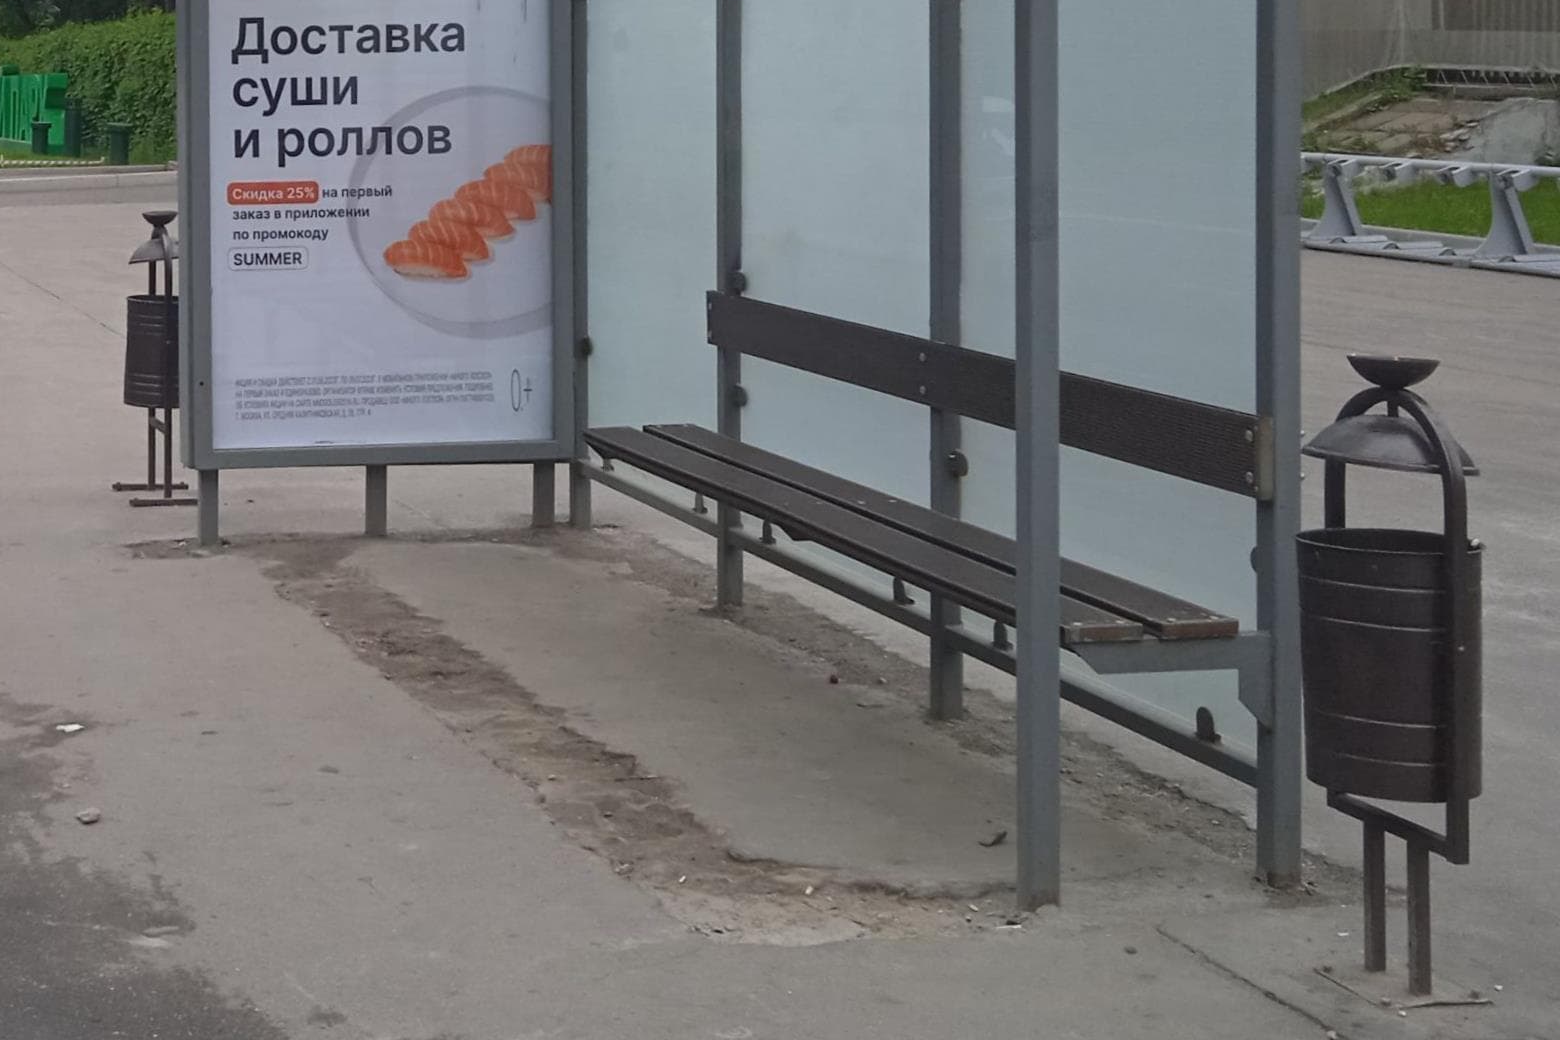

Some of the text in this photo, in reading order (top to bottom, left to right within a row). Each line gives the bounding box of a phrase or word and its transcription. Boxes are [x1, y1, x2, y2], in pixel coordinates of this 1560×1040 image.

[231, 17, 465, 64] Доставка
[233, 76, 358, 117] суши
[234, 125, 452, 168] и роллов
[232, 185, 392, 201] Скидка 25% на первый
[233, 208, 370, 221] заказ в приложении
[233, 228, 329, 242] по промокоду
[233, 252, 303, 266] SUMMER
